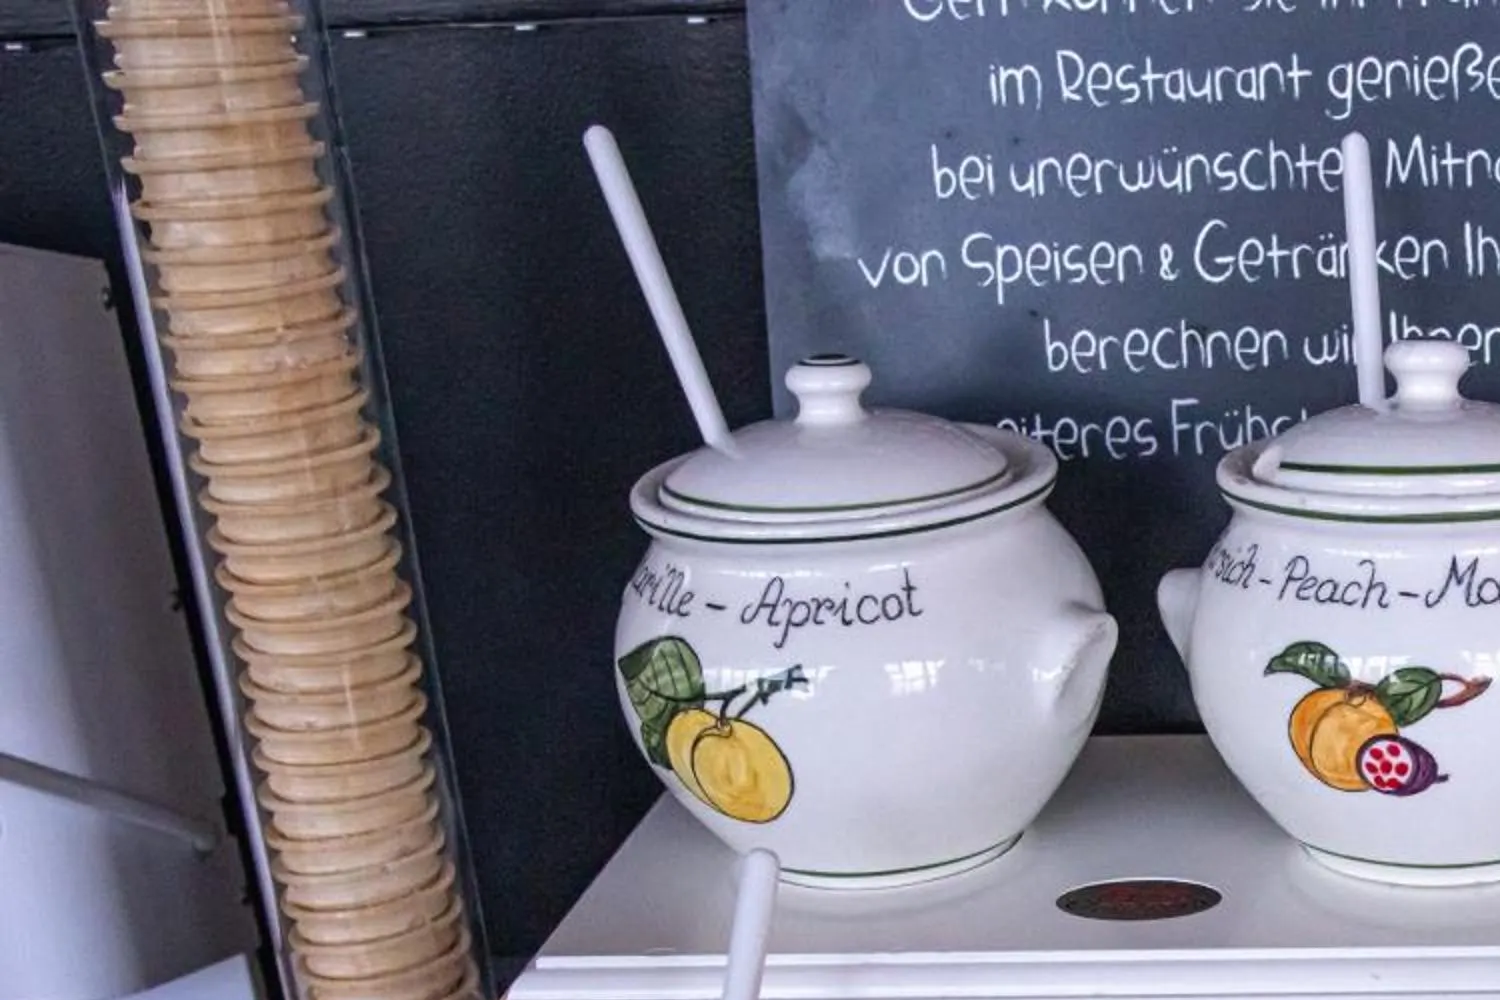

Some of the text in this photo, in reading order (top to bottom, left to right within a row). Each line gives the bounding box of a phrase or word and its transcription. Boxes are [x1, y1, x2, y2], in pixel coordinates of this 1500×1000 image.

[990, 64, 1041, 109] im
[1057, 50, 1312, 107] Restaurant
[931, 144, 995, 200] bei
[858, 246, 945, 287] von
[962, 232, 1143, 305] Speisen
[1159, 247, 1180, 281] &
[1044, 319, 1288, 373] berechnen
[1303, 324, 1358, 365] wi
[740, 566, 923, 649] Apricot
[1278, 555, 1390, 610] Peach
